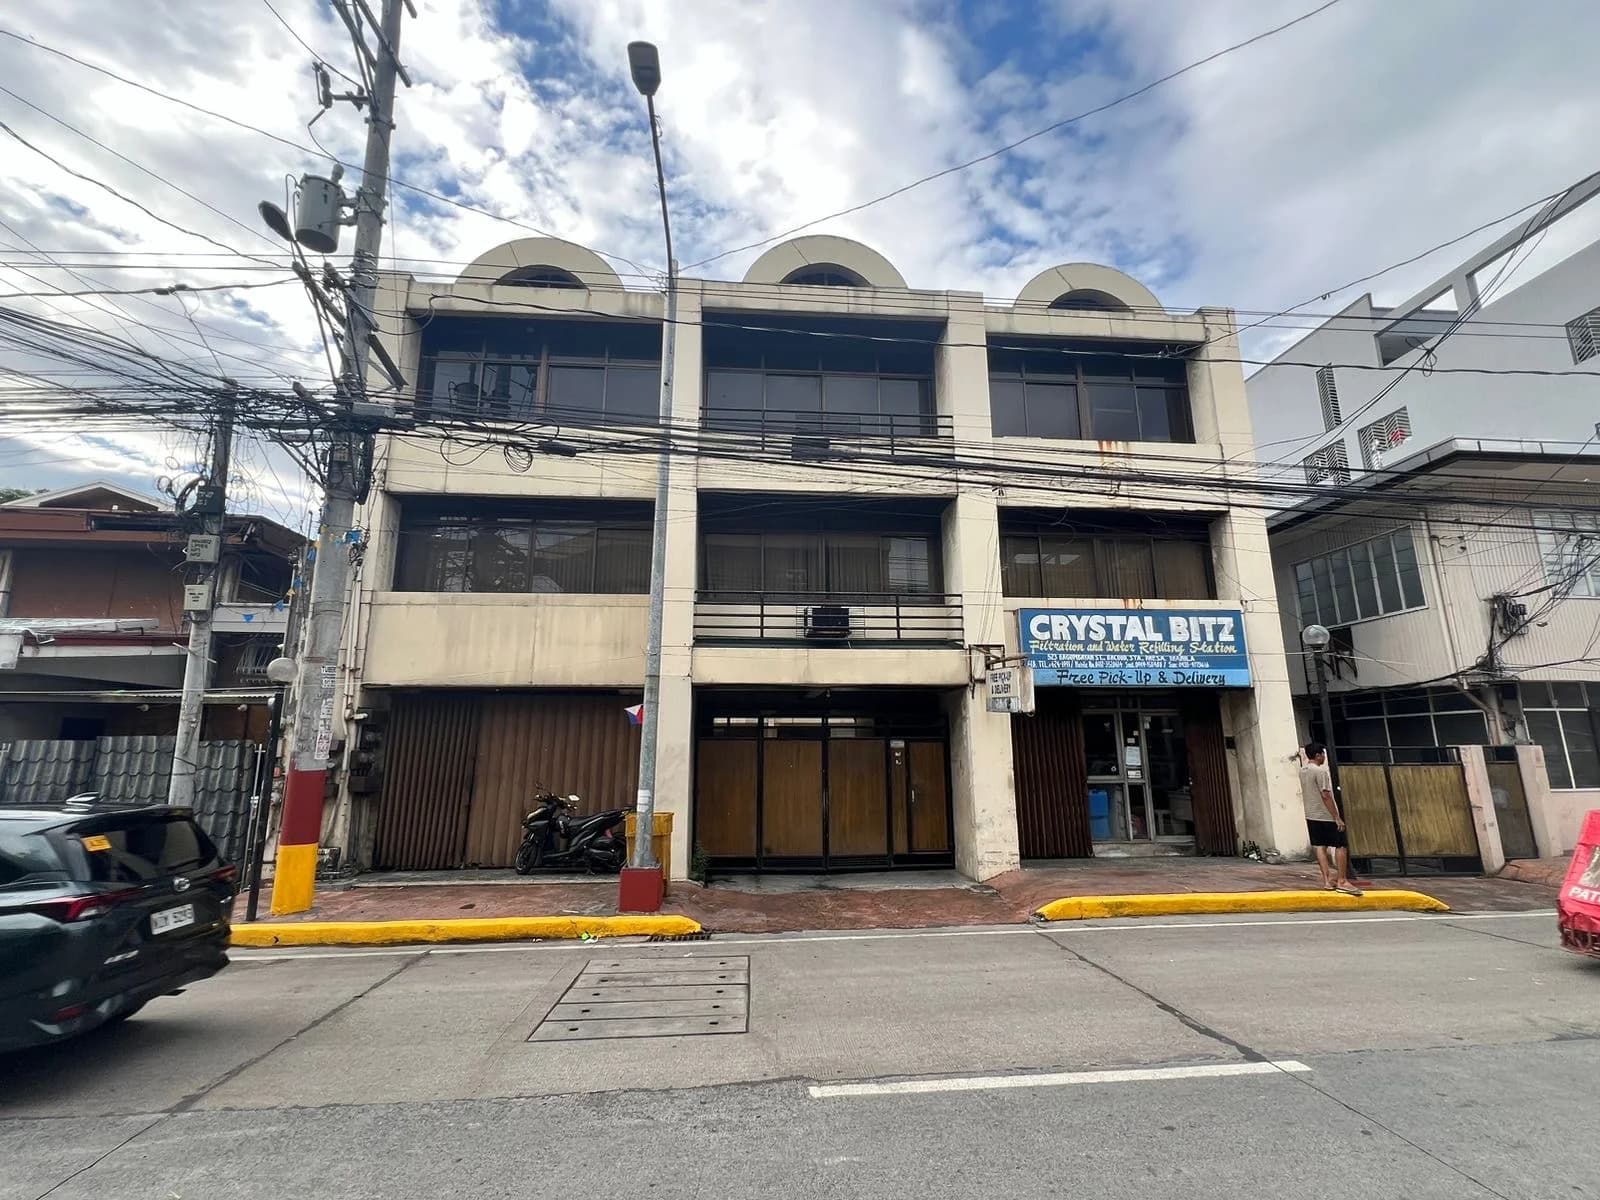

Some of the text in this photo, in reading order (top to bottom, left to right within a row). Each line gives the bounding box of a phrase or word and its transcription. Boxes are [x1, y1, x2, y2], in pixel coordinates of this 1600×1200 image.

[1029, 614, 1235, 642] CRYSTAL BITZ
[1029, 640, 1237, 656] Filtration and Water Refilling Station
[1056, 669, 1094, 685] Free
[1158, 670, 1169, 684] &
[1172, 671, 1226, 686] Delivery
[1568, 886, 1600, 903] PAT
